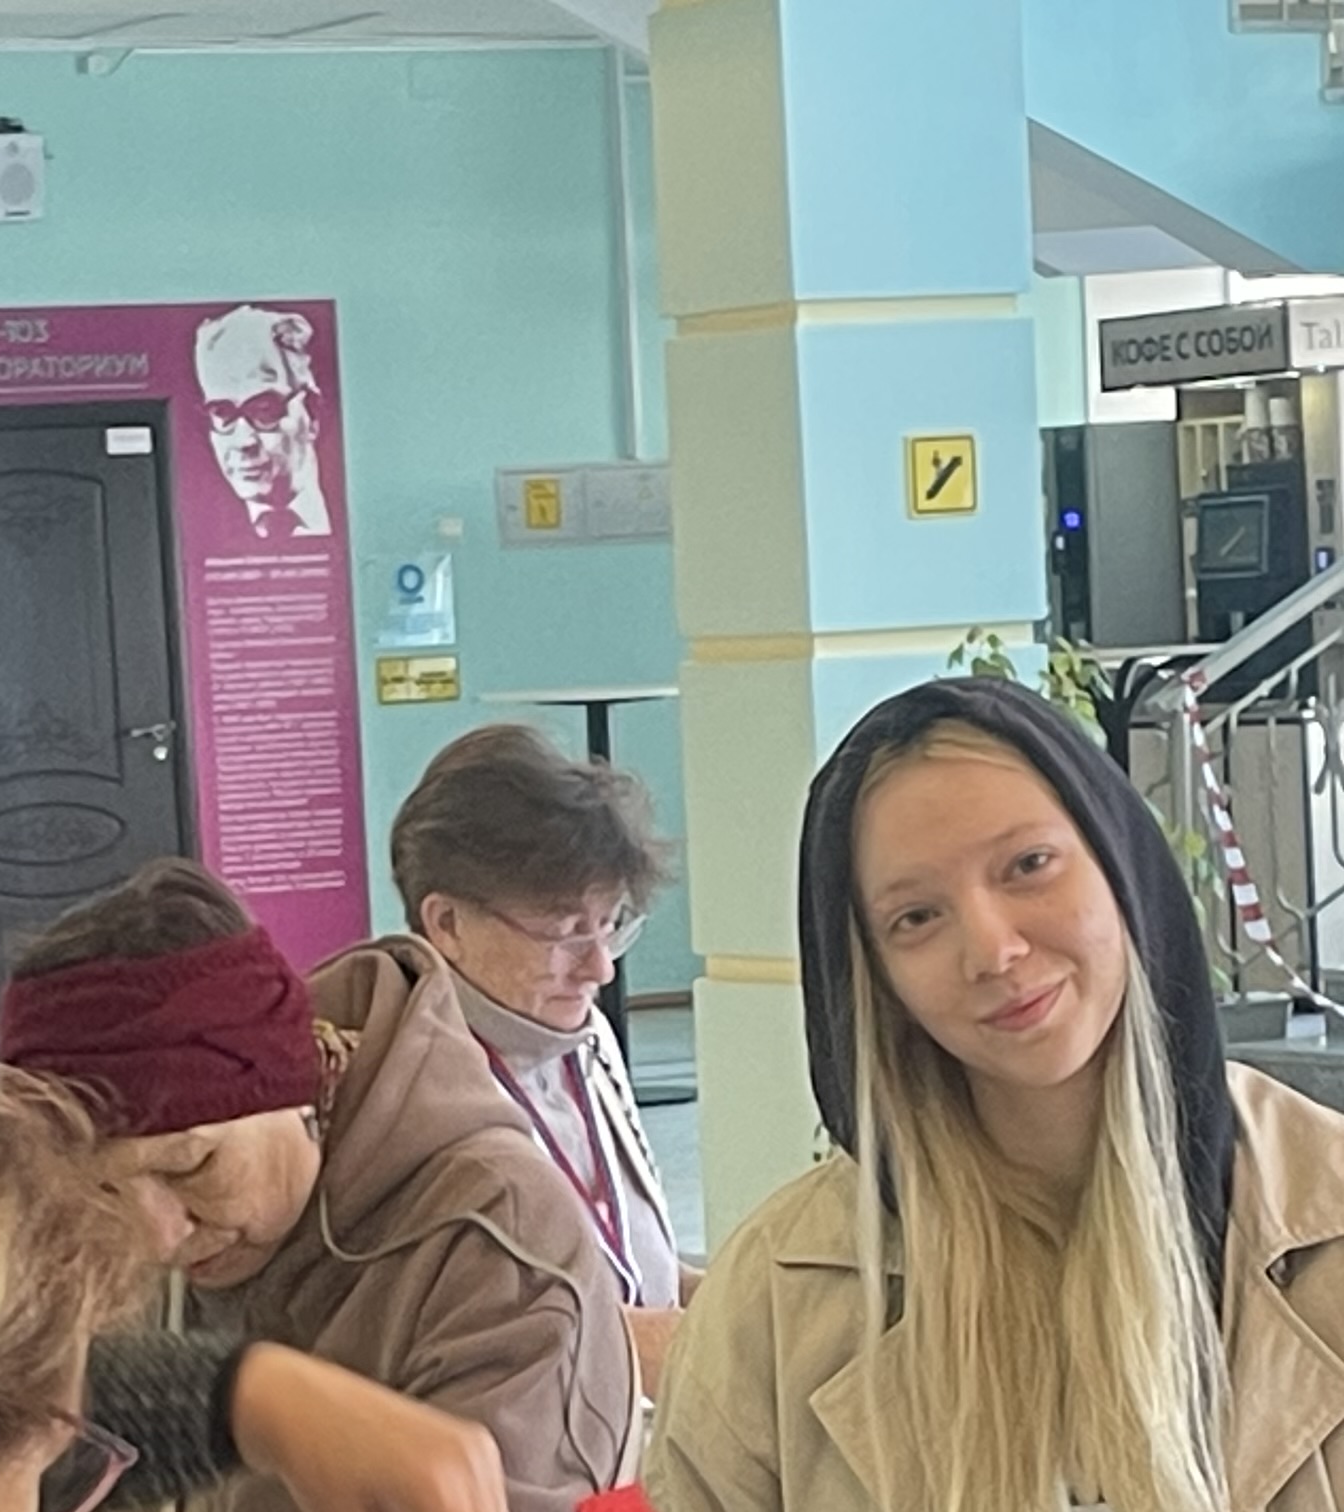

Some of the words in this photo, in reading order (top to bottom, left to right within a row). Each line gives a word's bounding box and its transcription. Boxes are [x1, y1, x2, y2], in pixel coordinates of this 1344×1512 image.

[1112, 333, 1172, 367] КОФЕ
[1175, 331, 1191, 360] С
[1194, 317, 1274, 358] СОБОЙ
